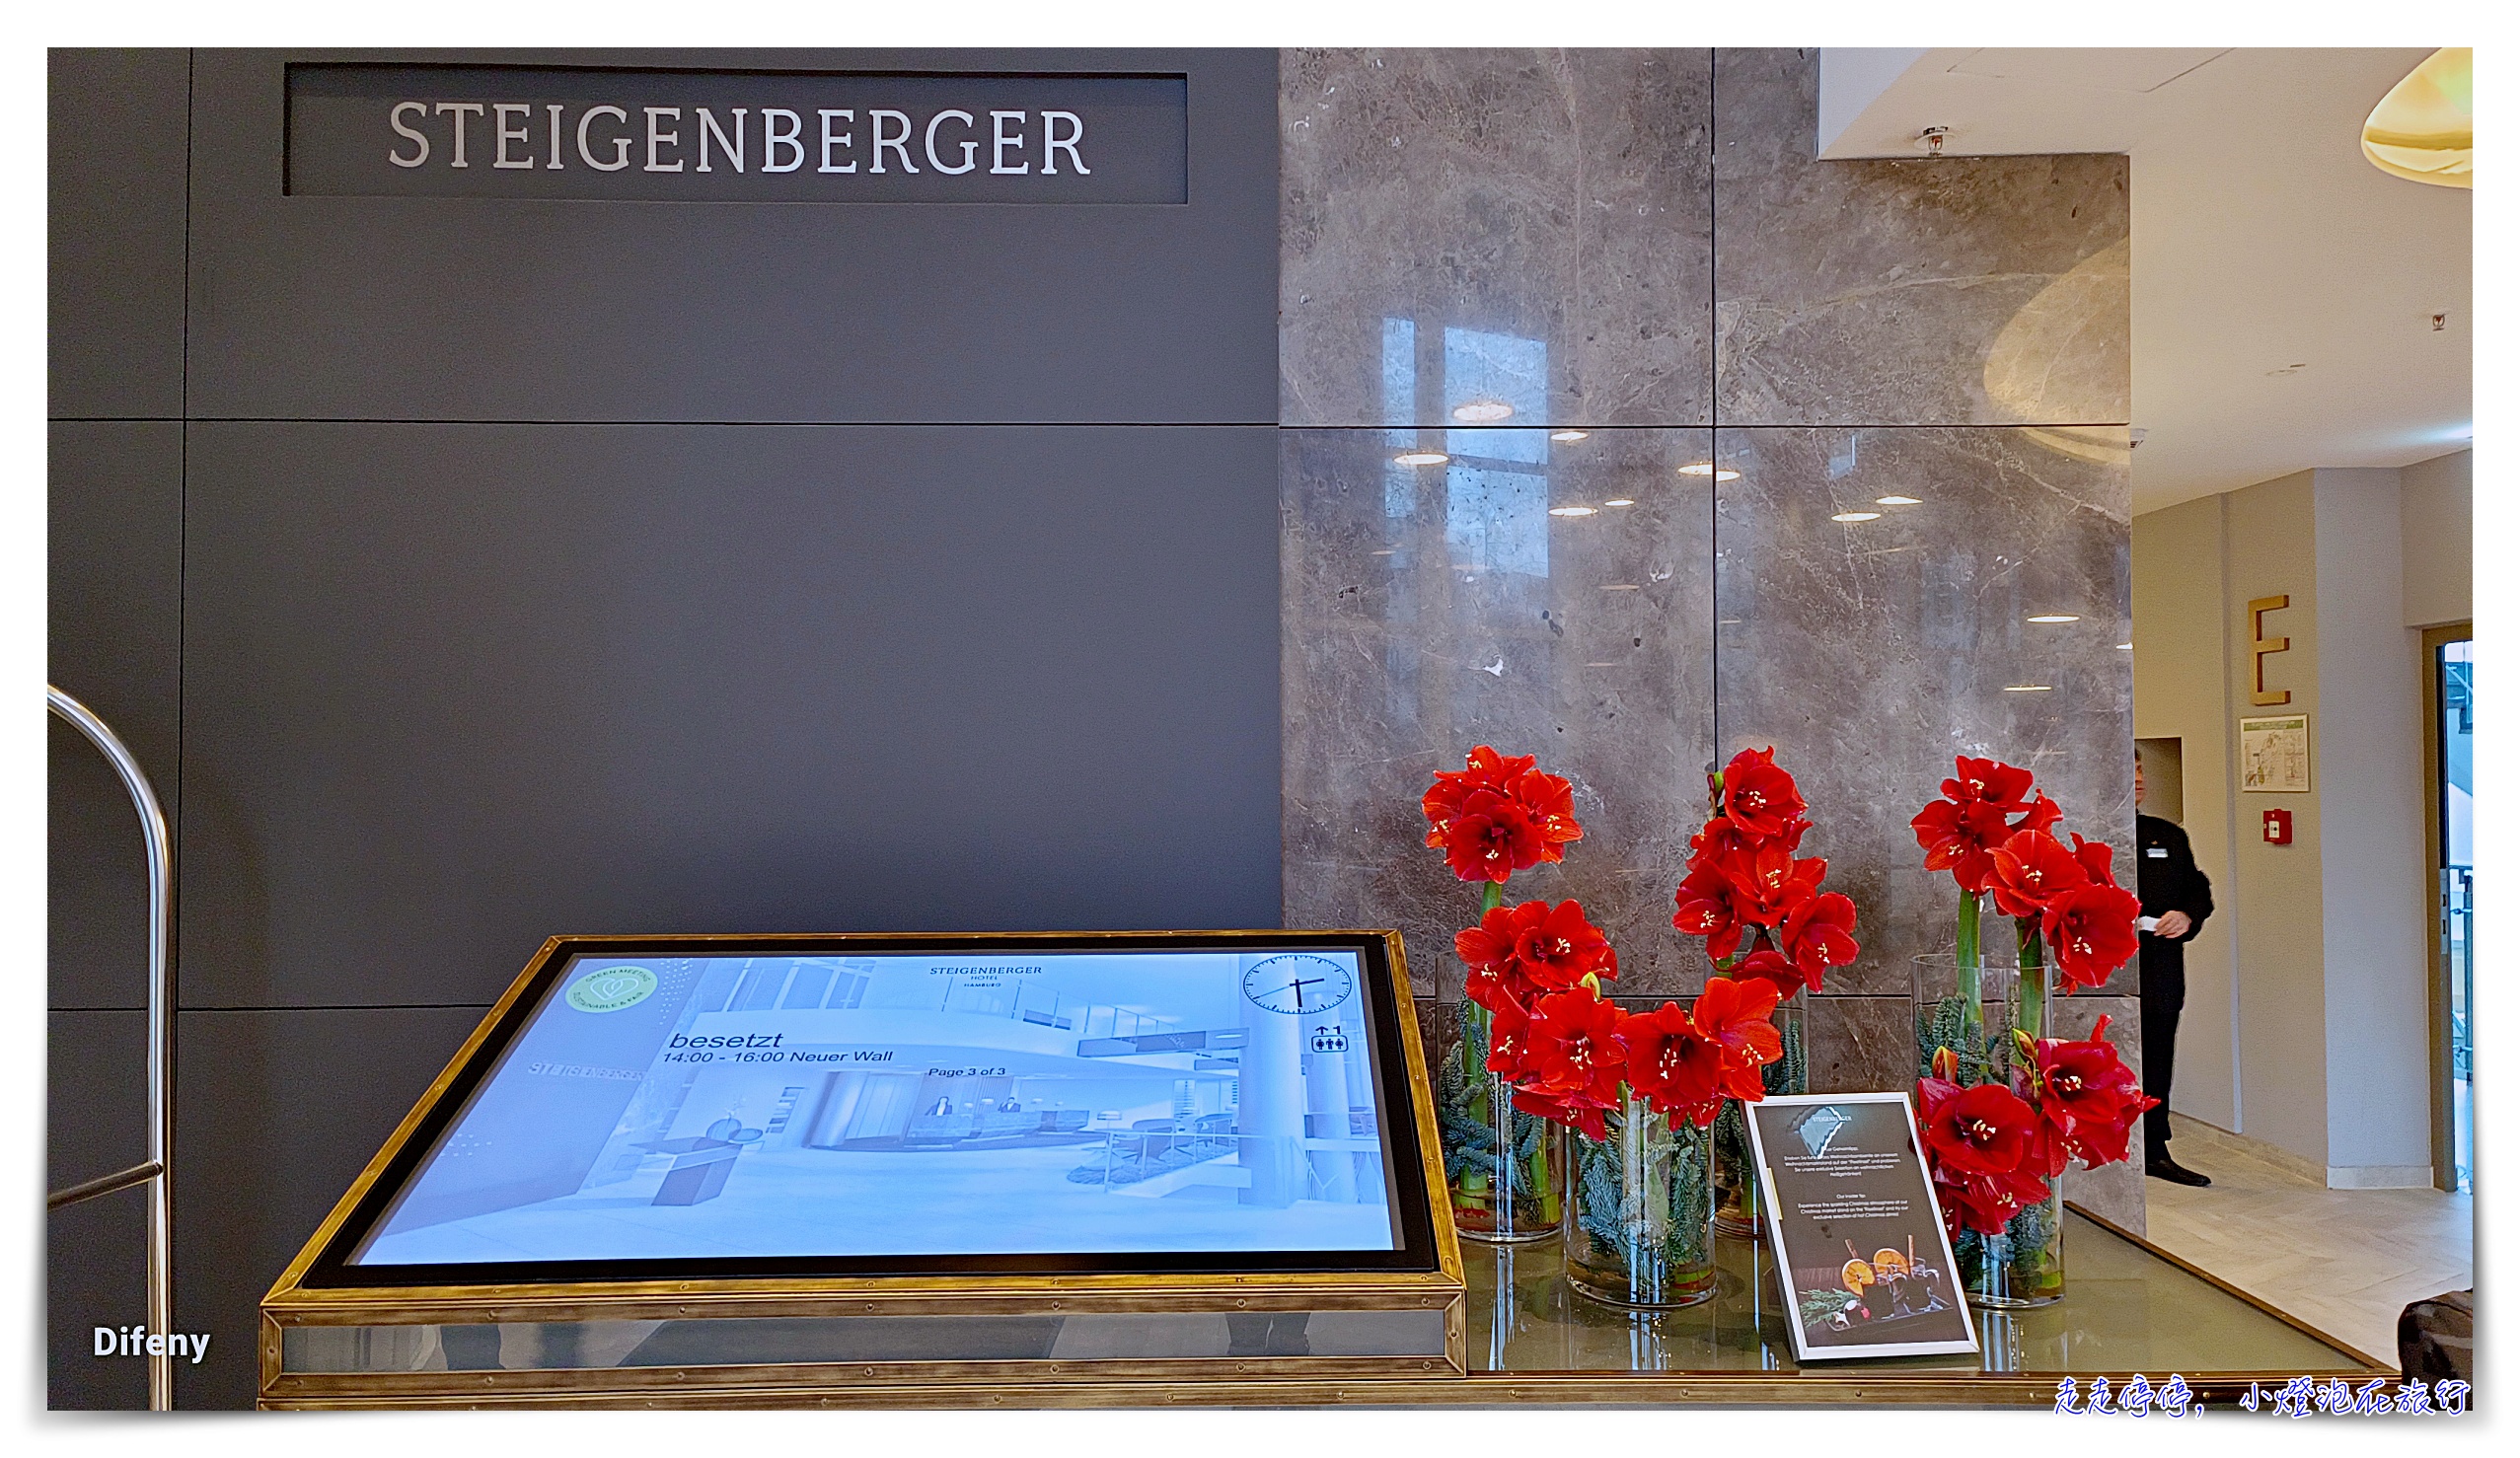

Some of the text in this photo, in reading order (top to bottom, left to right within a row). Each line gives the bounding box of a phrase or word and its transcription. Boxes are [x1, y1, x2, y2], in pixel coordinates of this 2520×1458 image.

[389, 101, 1091, 176] STEIGENBERGER
[2248, 595, 2291, 706] E
[929, 966, 1042, 975] STEIGENBERGER
[669, 1033, 783, 1049] besetzt
[663, 1052, 713, 1062] 14:00
[733, 1052, 784, 1062] 16:00
[789, 1051, 849, 1062] Neuer
[852, 1051, 893, 1061] Wall
[928, 1067, 963, 1077] Page
